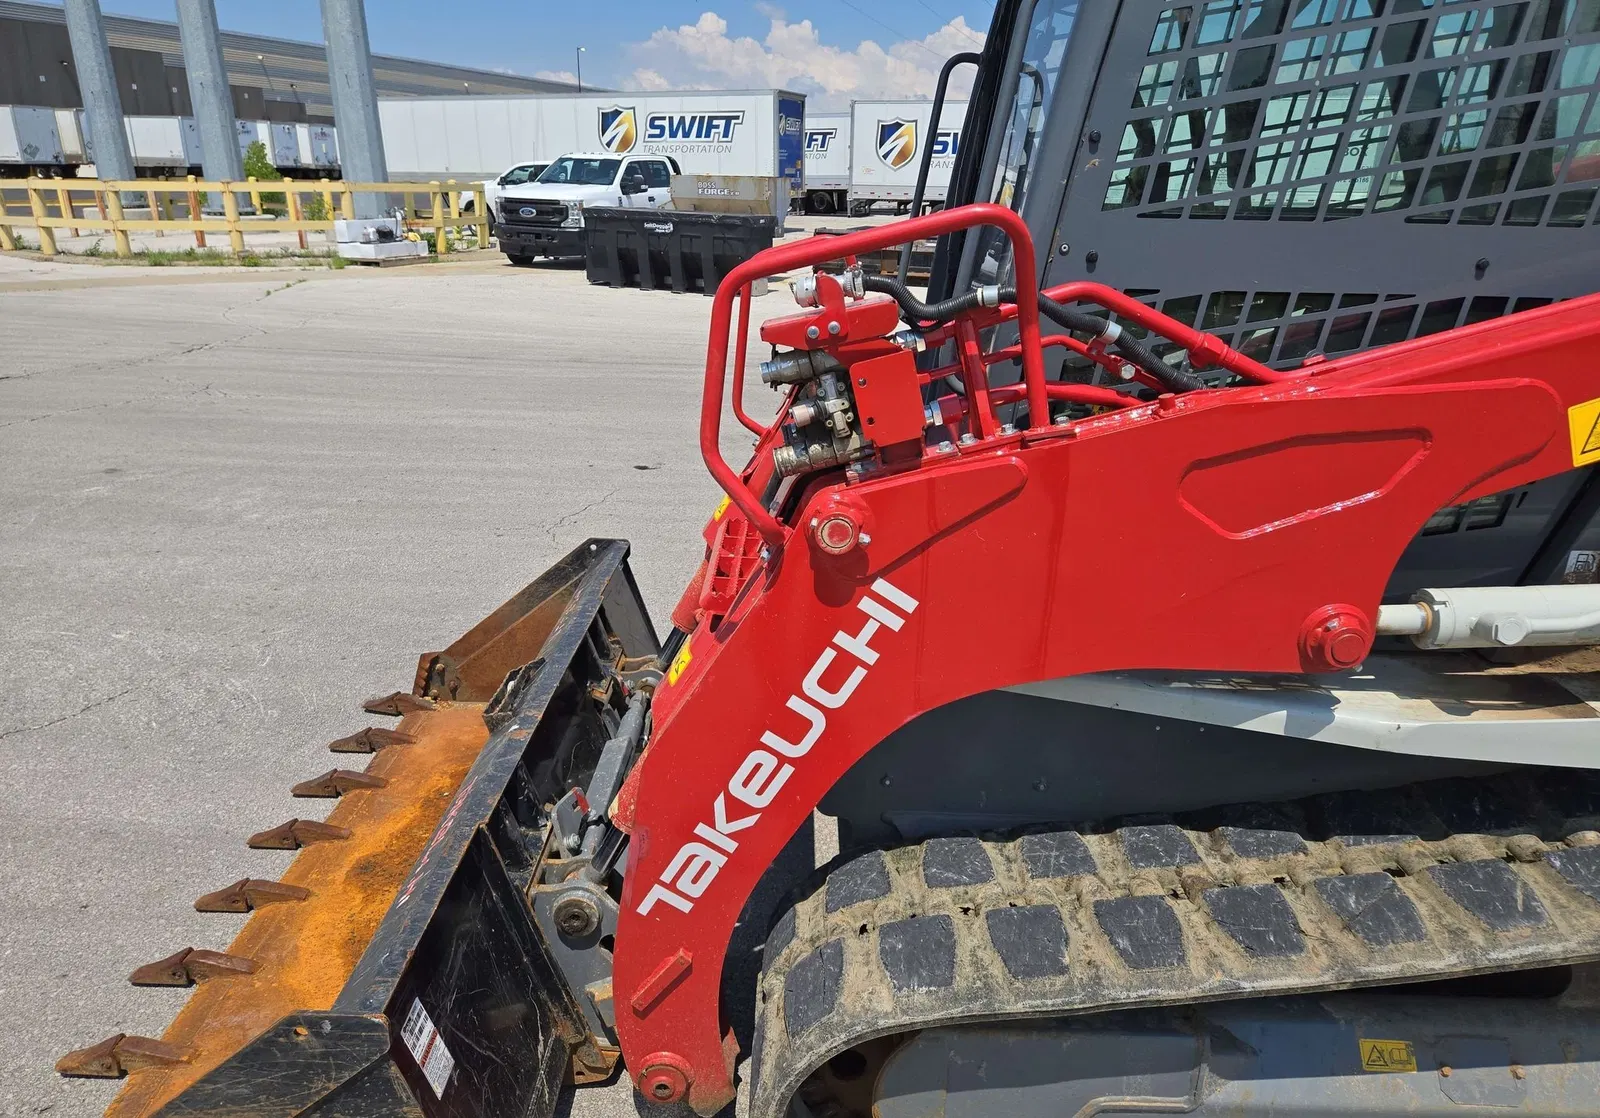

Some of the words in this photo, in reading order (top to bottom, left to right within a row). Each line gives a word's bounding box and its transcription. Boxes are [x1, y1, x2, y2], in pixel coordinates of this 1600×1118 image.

[647, 115, 741, 139] SWIFT
[643, 144, 733, 154] TRANSPORTATION
[697, 181, 716, 189] BOSS
[698, 188, 730, 196] FORGE
[636, 577, 920, 916] TAKEUCHI
